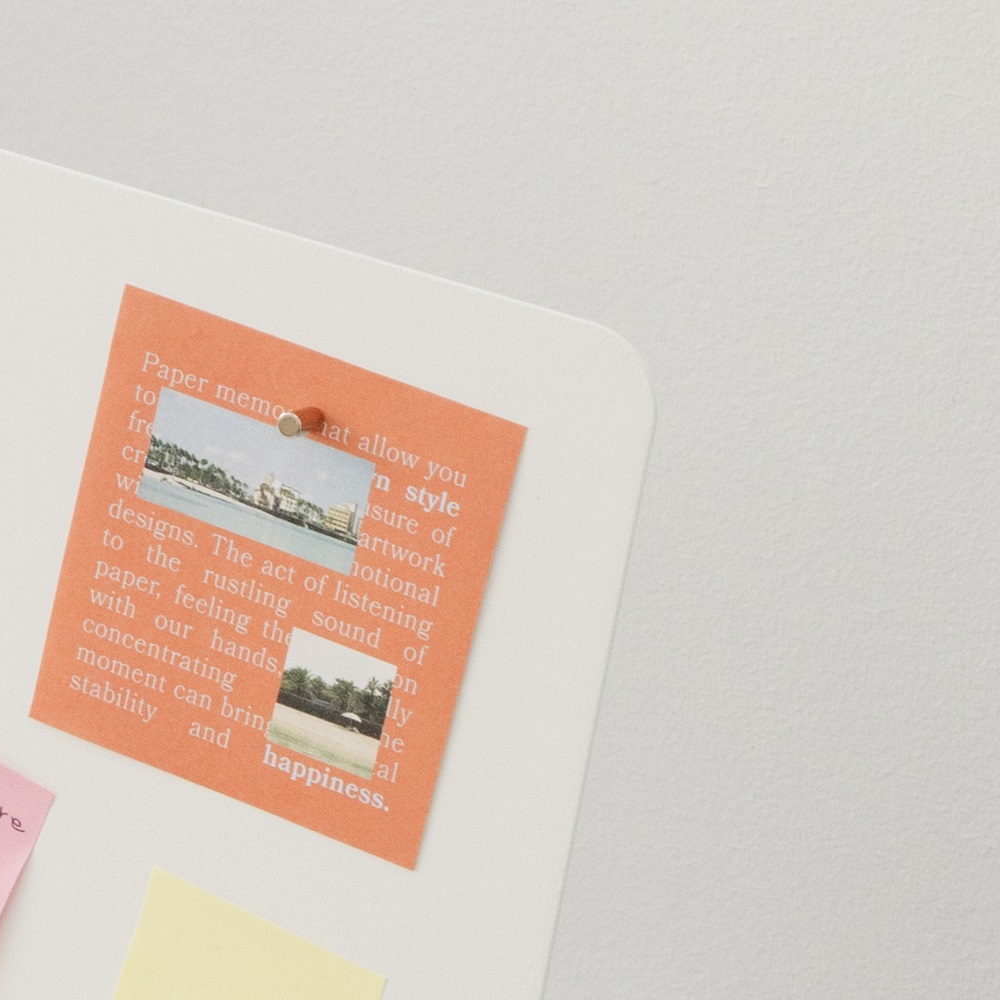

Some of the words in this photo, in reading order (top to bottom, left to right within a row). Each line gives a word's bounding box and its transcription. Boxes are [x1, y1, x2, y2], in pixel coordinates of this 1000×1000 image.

[135, 384, 157, 406] to
[404, 484, 461, 518] style
[141, 351, 209, 393] Paper
[357, 434, 421, 469] allow
[424, 460, 467, 488] you
[108, 498, 199, 549] designs.
[211, 532, 254, 569] The
[261, 559, 296, 584] act
[303, 574, 330, 596] of
[333, 580, 434, 641] listening
[358, 531, 447, 578] artwork
[431, 526, 457, 548] of
[89, 588, 137, 619] with
[155, 613, 194, 640] our
[93, 559, 162, 600] paper,
[174, 583, 252, 635] feeling
[102, 529, 124, 551] to
[146, 544, 182, 573] the
[203, 568, 292, 618] rustling
[312, 610, 382, 649] sound
[403, 645, 430, 667] of
[75, 646, 168, 693] moment
[173, 683, 213, 711] can
[81, 617, 238, 693] concentrating
[69, 673, 159, 723] stability
[188, 718, 231, 752] and
[262, 743, 390, 813] happiness.
